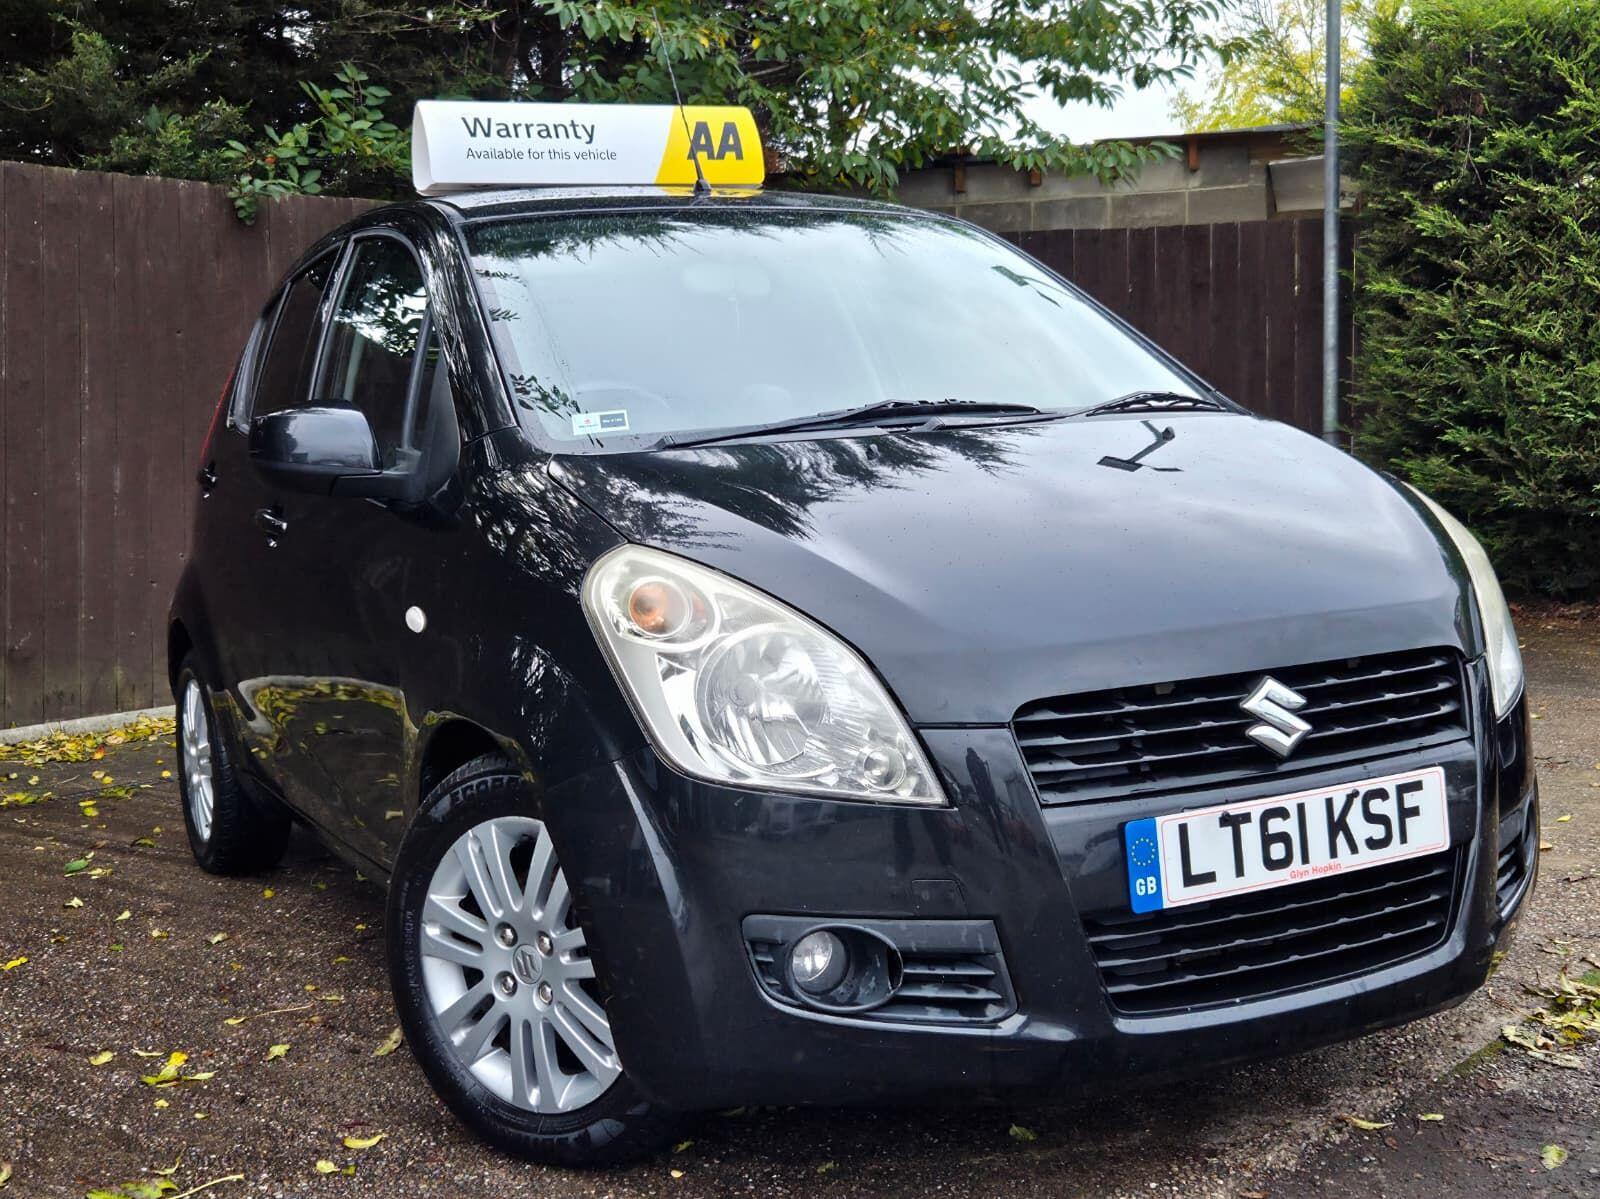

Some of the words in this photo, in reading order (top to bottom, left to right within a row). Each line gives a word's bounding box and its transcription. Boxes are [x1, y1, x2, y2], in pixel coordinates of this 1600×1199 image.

[461, 116, 595, 144] Warranty
[687, 121, 744, 161] AA
[466, 147, 524, 160] Available
[528, 147, 545, 160] for
[548, 148, 571, 160] this
[573, 149, 617, 160] vehicle
[1178, 802, 1309, 888] LT61
[1325, 780, 1424, 859] KSF
[1289, 868, 1310, 880] Glyn
[1311, 861, 1342, 875] Hopkin
[1135, 876, 1157, 896] GB
